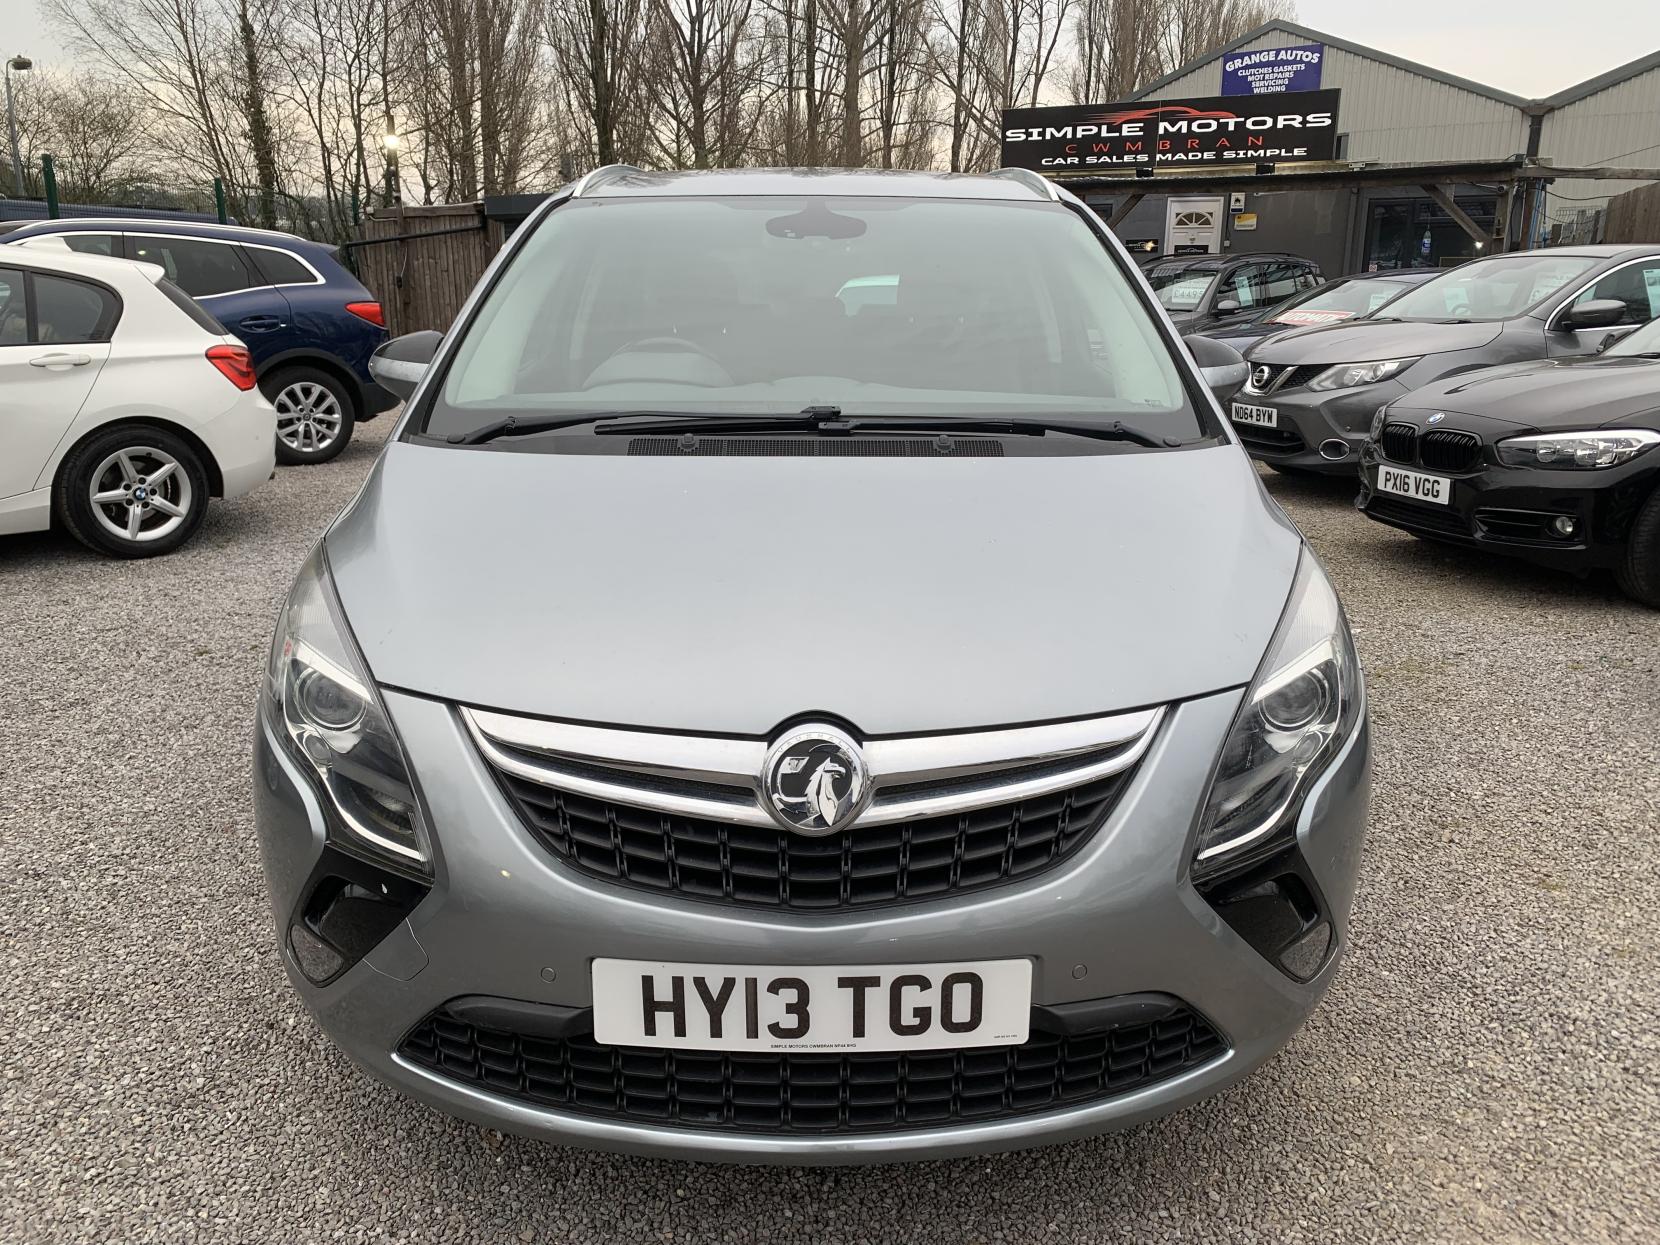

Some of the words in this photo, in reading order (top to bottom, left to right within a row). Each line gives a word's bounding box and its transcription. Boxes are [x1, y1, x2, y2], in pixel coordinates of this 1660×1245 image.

[1225, 50, 1276, 71] GRANGE
[1278, 50, 1320, 63] AUTOS
[1238, 66, 1272, 76] CLUTCHES
[1273, 64, 1305, 73] GASKETS
[1247, 74, 1264, 82] MOT
[1264, 72, 1294, 80] REPAIRS
[1251, 79, 1289, 88] SERVICING
[1253, 85, 1286, 94] WELDING
[1005, 122, 1144, 142] SIMPLE
[1158, 112, 1332, 135] MOTORS
[1041, 156, 1080, 166] CAR
[1085, 154, 1149, 164] SALES
[1156, 151, 1216, 161] MADE
[1223, 147, 1308, 159] SIMPLE
[1234, 405, 1254, 421] ND64
[1255, 408, 1273, 424] BYW
[1384, 471, 1410, 493] PX16
[1414, 476, 1441, 499] VGG
[641, 974, 811, 1040] HY13
[837, 971, 984, 1039] TGO
